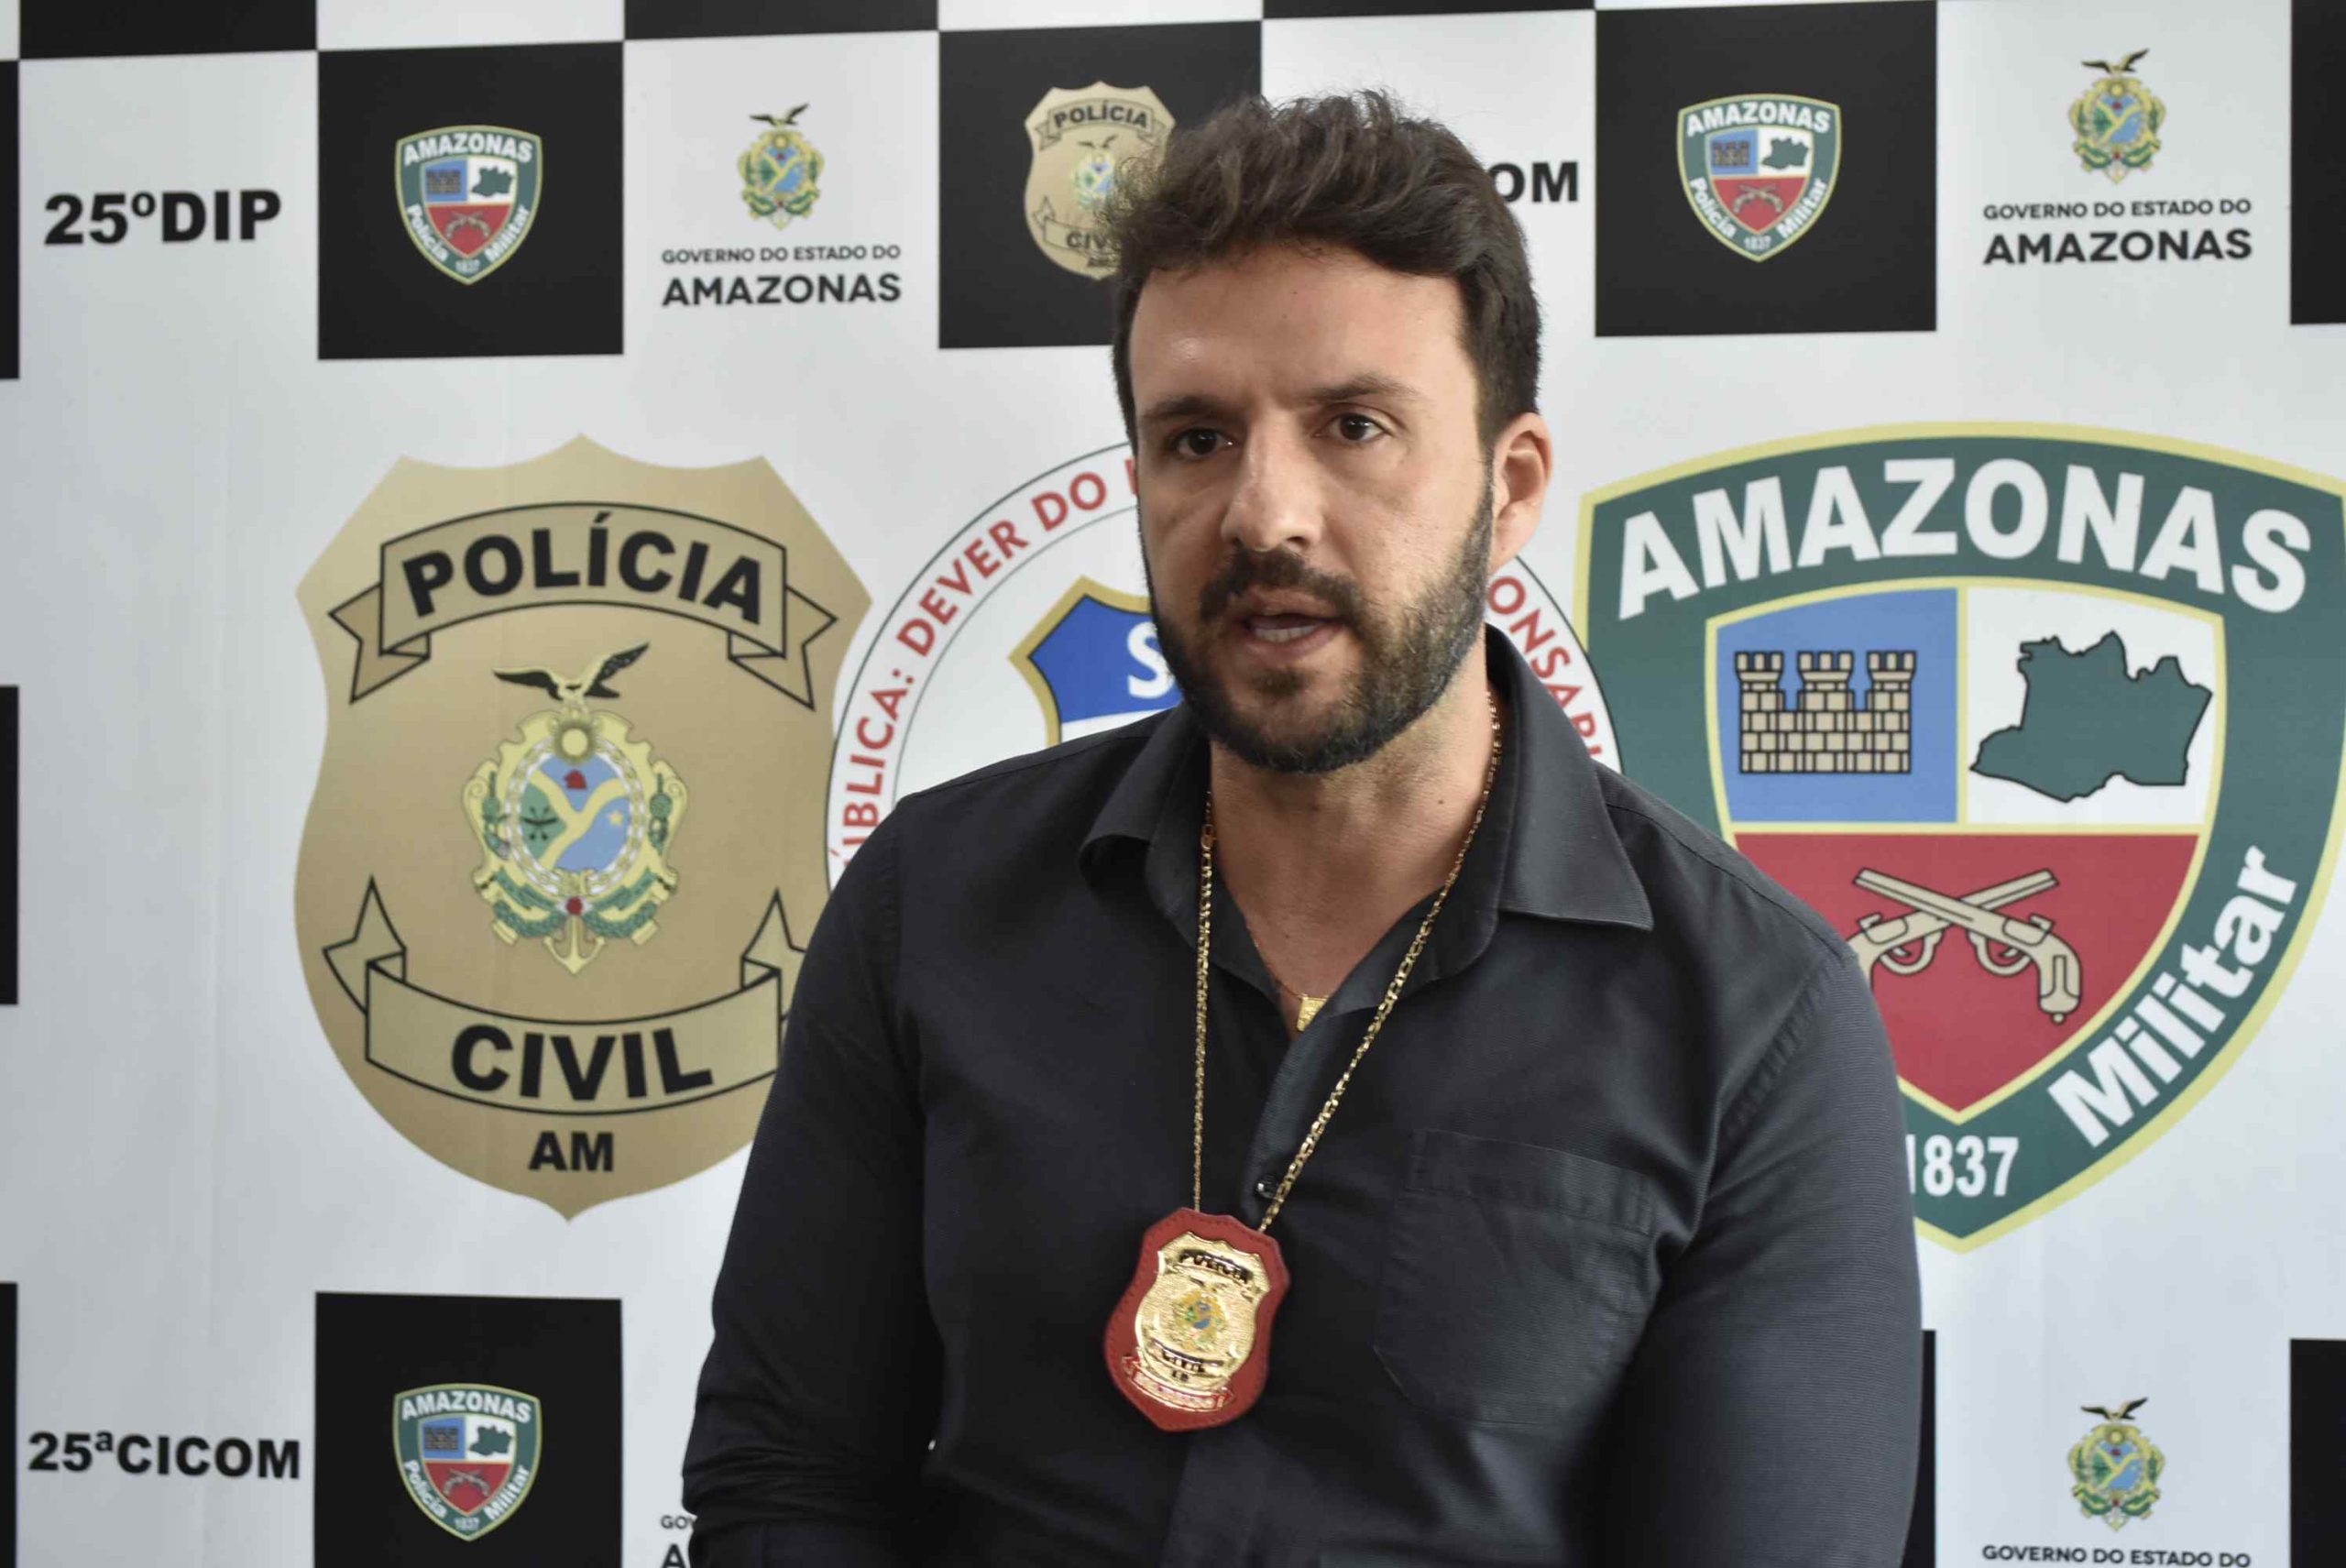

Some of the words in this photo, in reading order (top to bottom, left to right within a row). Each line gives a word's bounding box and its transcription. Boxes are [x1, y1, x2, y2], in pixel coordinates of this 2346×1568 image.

[1054, 101, 1148, 128] POLÍCIA
[1687, 101, 1831, 137] AMAZONAS
[404, 132, 533, 166] AMAZONAS
[1776, 178, 1827, 239] Militar
[1983, 203, 2088, 220] GOVERNO
[2093, 202, 2125, 217] DO
[2131, 200, 2213, 216] ESTADO
[2220, 199, 2252, 214] DO
[662, 247, 754, 265] GOVERNO
[760, 247, 788, 262] DO
[794, 245, 868, 261] ESTADO
[872, 245, 901, 259] DO
[1982, 227, 2253, 265] AMAZONAS
[662, 272, 902, 307] AMAZONAS
[1618, 457, 2311, 621] AMAZONAS
[401, 511, 761, 625] POLÍCIA
[895, 520, 1029, 657] DEVER
[1030, 471, 1107, 532] DO
[2047, 845, 2297, 1148] Militar
[451, 1024, 713, 1102] CIVIL
[528, 1131, 615, 1172] AM
[401, 1390, 532, 1423] AMAZONAS
[483, 1464, 530, 1520] Militar
[1982, 1544, 2088, 1563] GOVERNO
[2093, 1548, 2124, 1564] DO
[2131, 1549, 2213, 1567] ESTADO
[2219, 1552, 2251, 1568] DO
